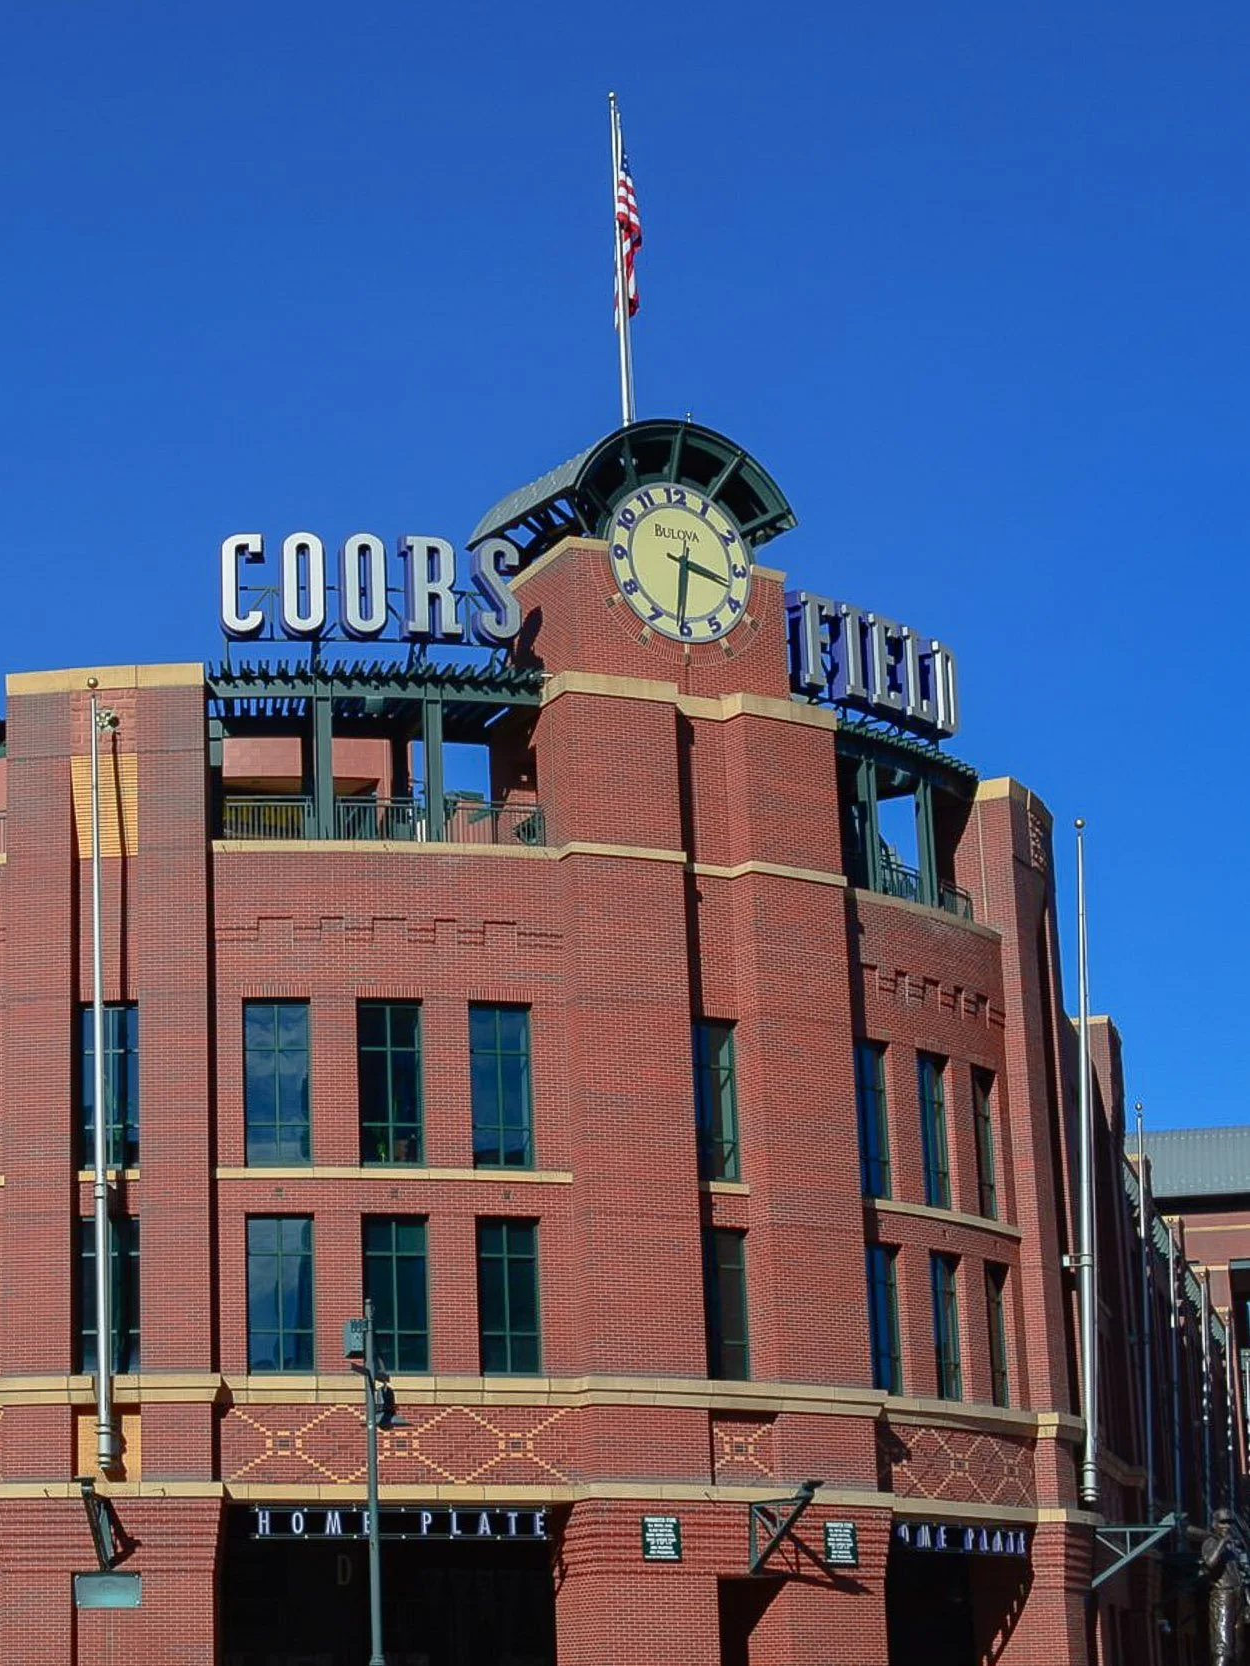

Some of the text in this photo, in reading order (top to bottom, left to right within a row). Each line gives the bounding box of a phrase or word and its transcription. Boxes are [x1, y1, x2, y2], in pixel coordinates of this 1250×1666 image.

[636, 491, 656, 510] 11
[664, 488, 687, 507] 12
[699, 502, 711, 517] 1
[616, 508, 636, 531] 10
[720, 529, 736, 547] 2
[613, 543, 628, 560] 9
[732, 563, 747, 579] 3
[623, 578, 639, 596] 8
[646, 606, 664, 622] 7
[727, 597, 742, 614] 4
[221, 532, 959, 736] COORS FIELD
[679, 620, 692, 637] 6
[707, 616, 722, 634] 5
[258, 1510, 546, 1536] HOME PLATE
